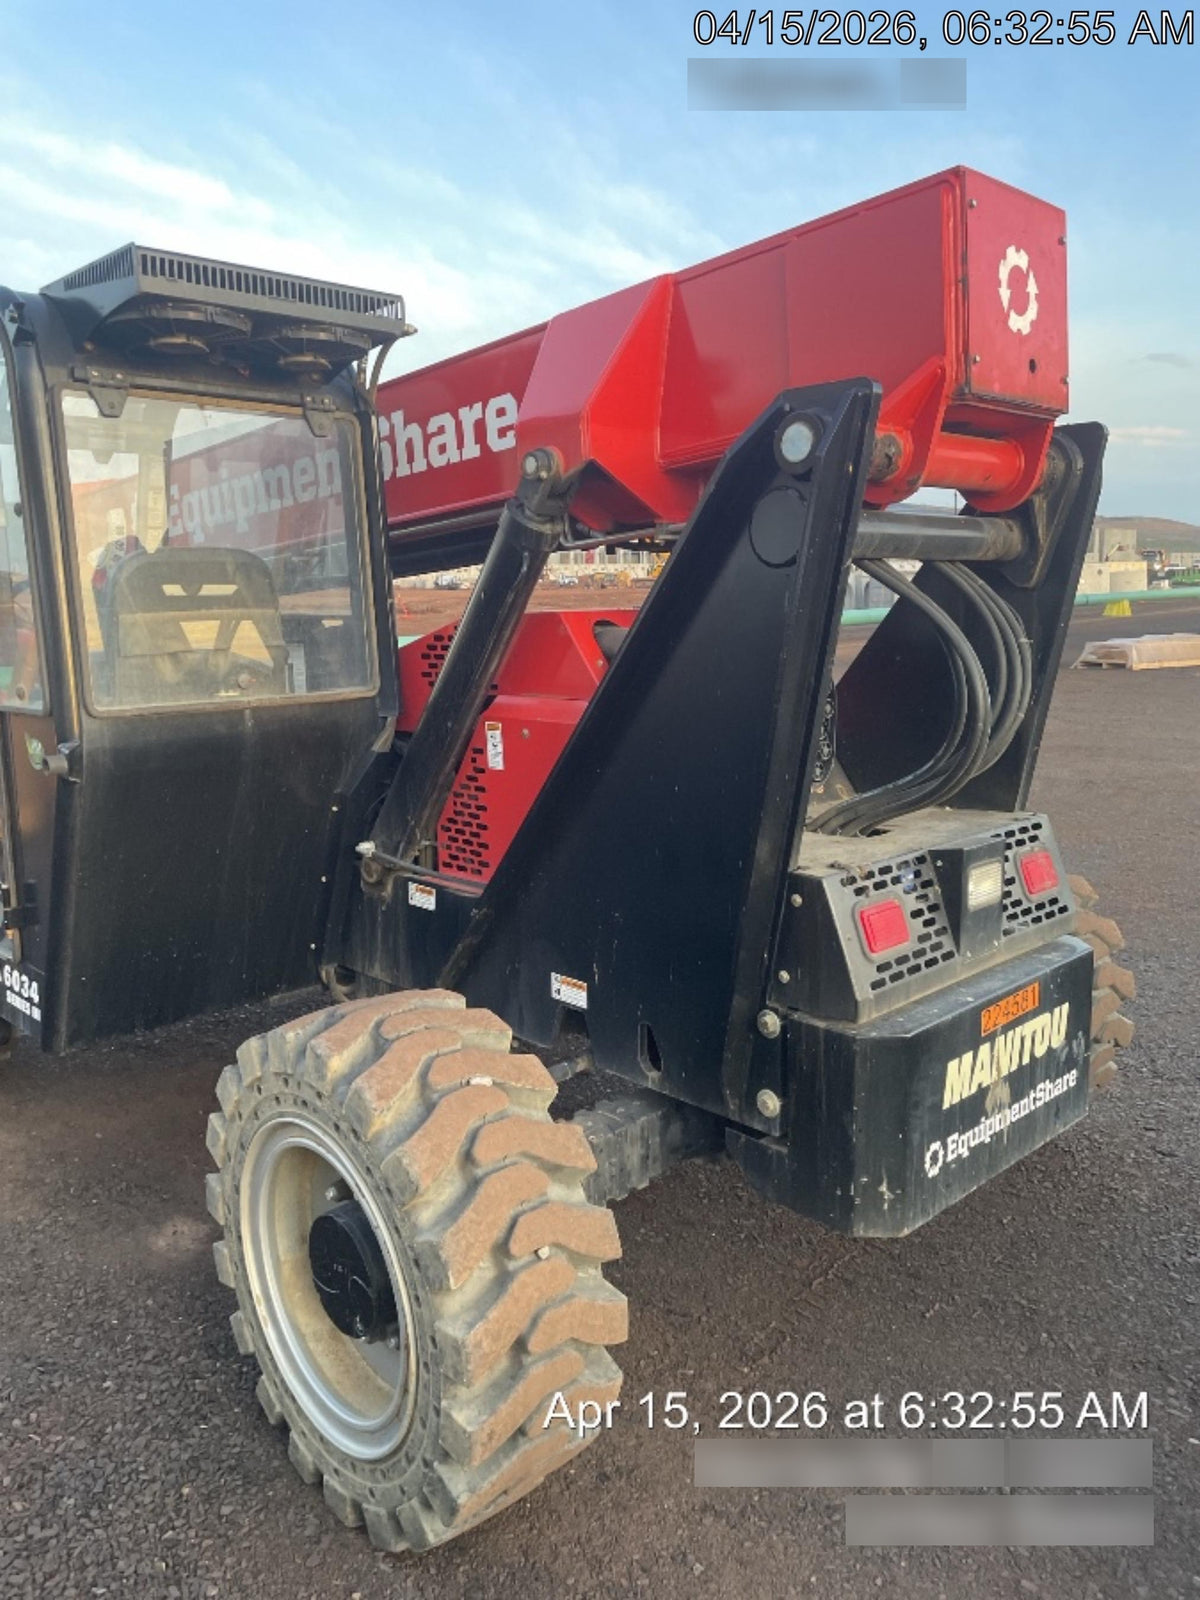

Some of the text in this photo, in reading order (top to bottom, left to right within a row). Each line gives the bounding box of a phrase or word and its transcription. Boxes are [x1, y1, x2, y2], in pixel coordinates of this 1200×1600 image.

[3, 964, 40, 1004] 6034
[942, 1001, 1070, 1110] MANITOU
[945, 1068, 1078, 1162] EquipmentShare
